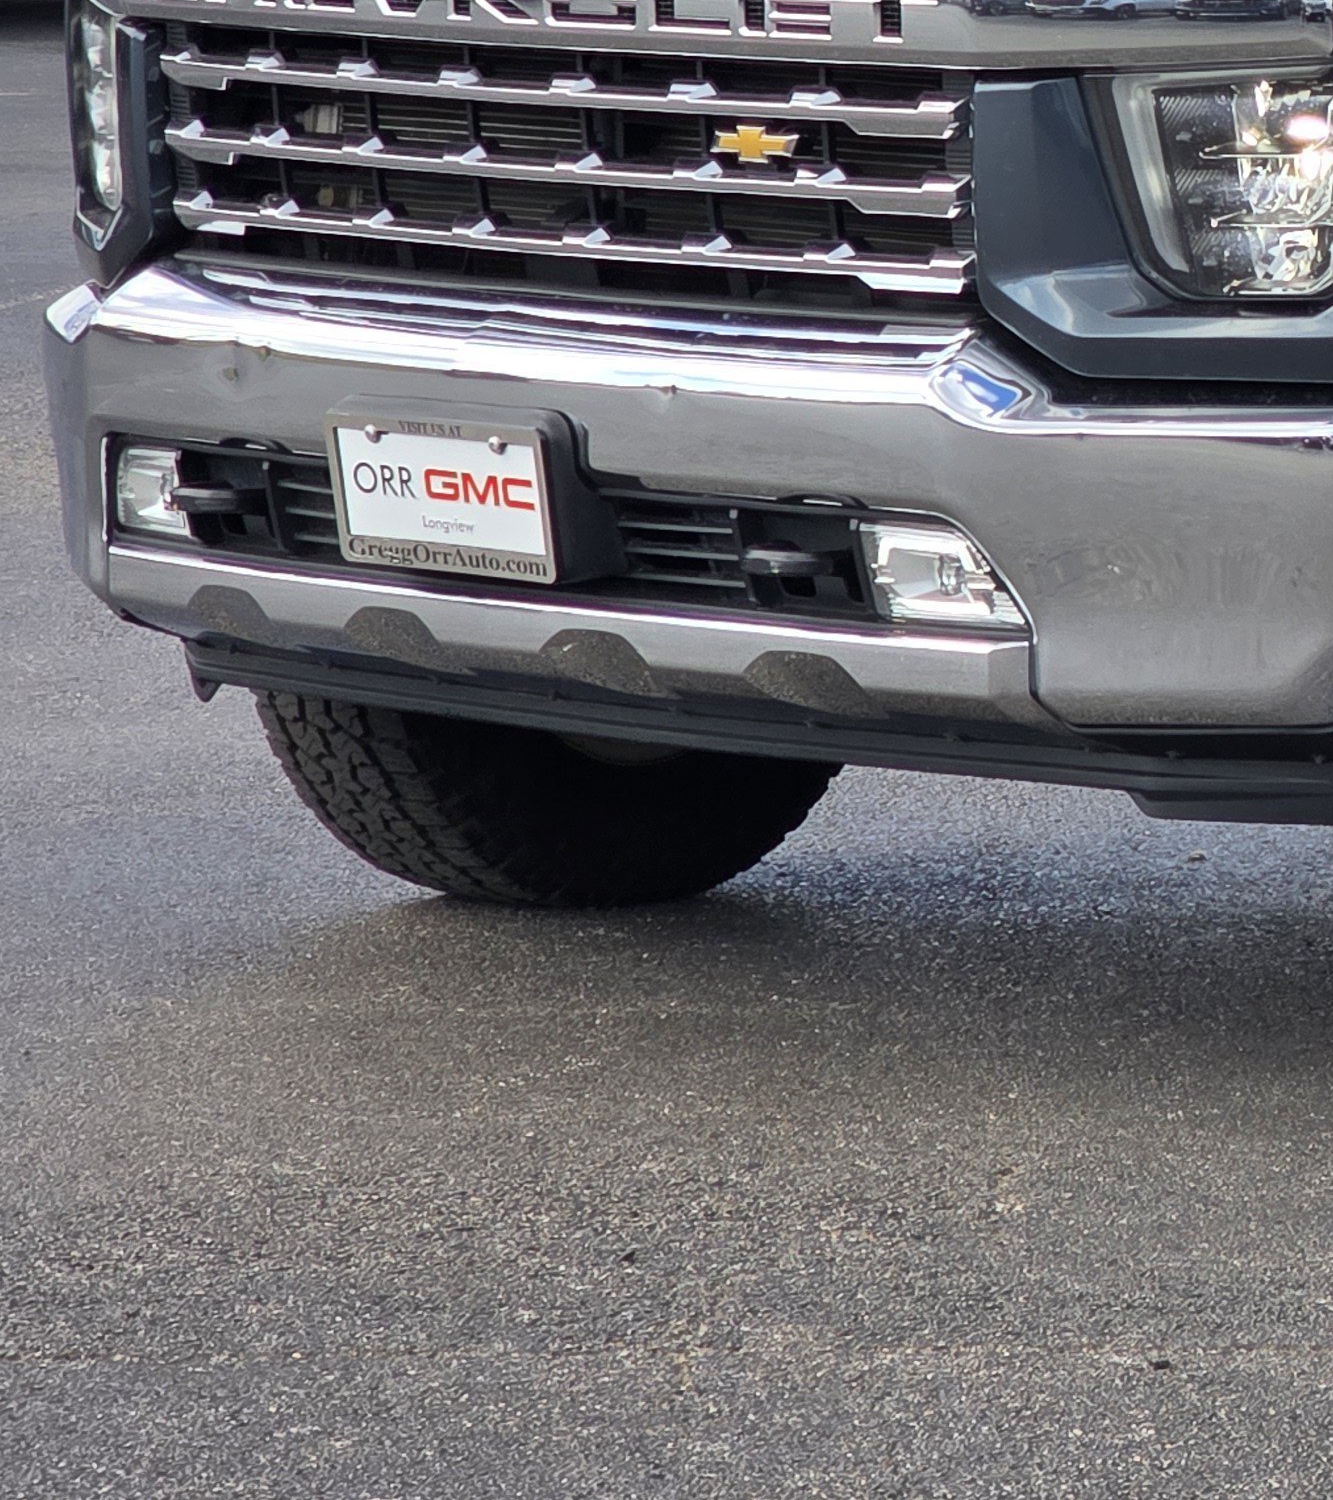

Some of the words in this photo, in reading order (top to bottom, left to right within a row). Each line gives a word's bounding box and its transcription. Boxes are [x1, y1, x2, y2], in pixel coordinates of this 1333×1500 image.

[448, 424, 462, 438] AT
[353, 461, 417, 499] ORR
[423, 468, 536, 511] GMC
[421, 514, 476, 535] Longview
[348, 536, 548, 578] GreggOrrAuto.com
